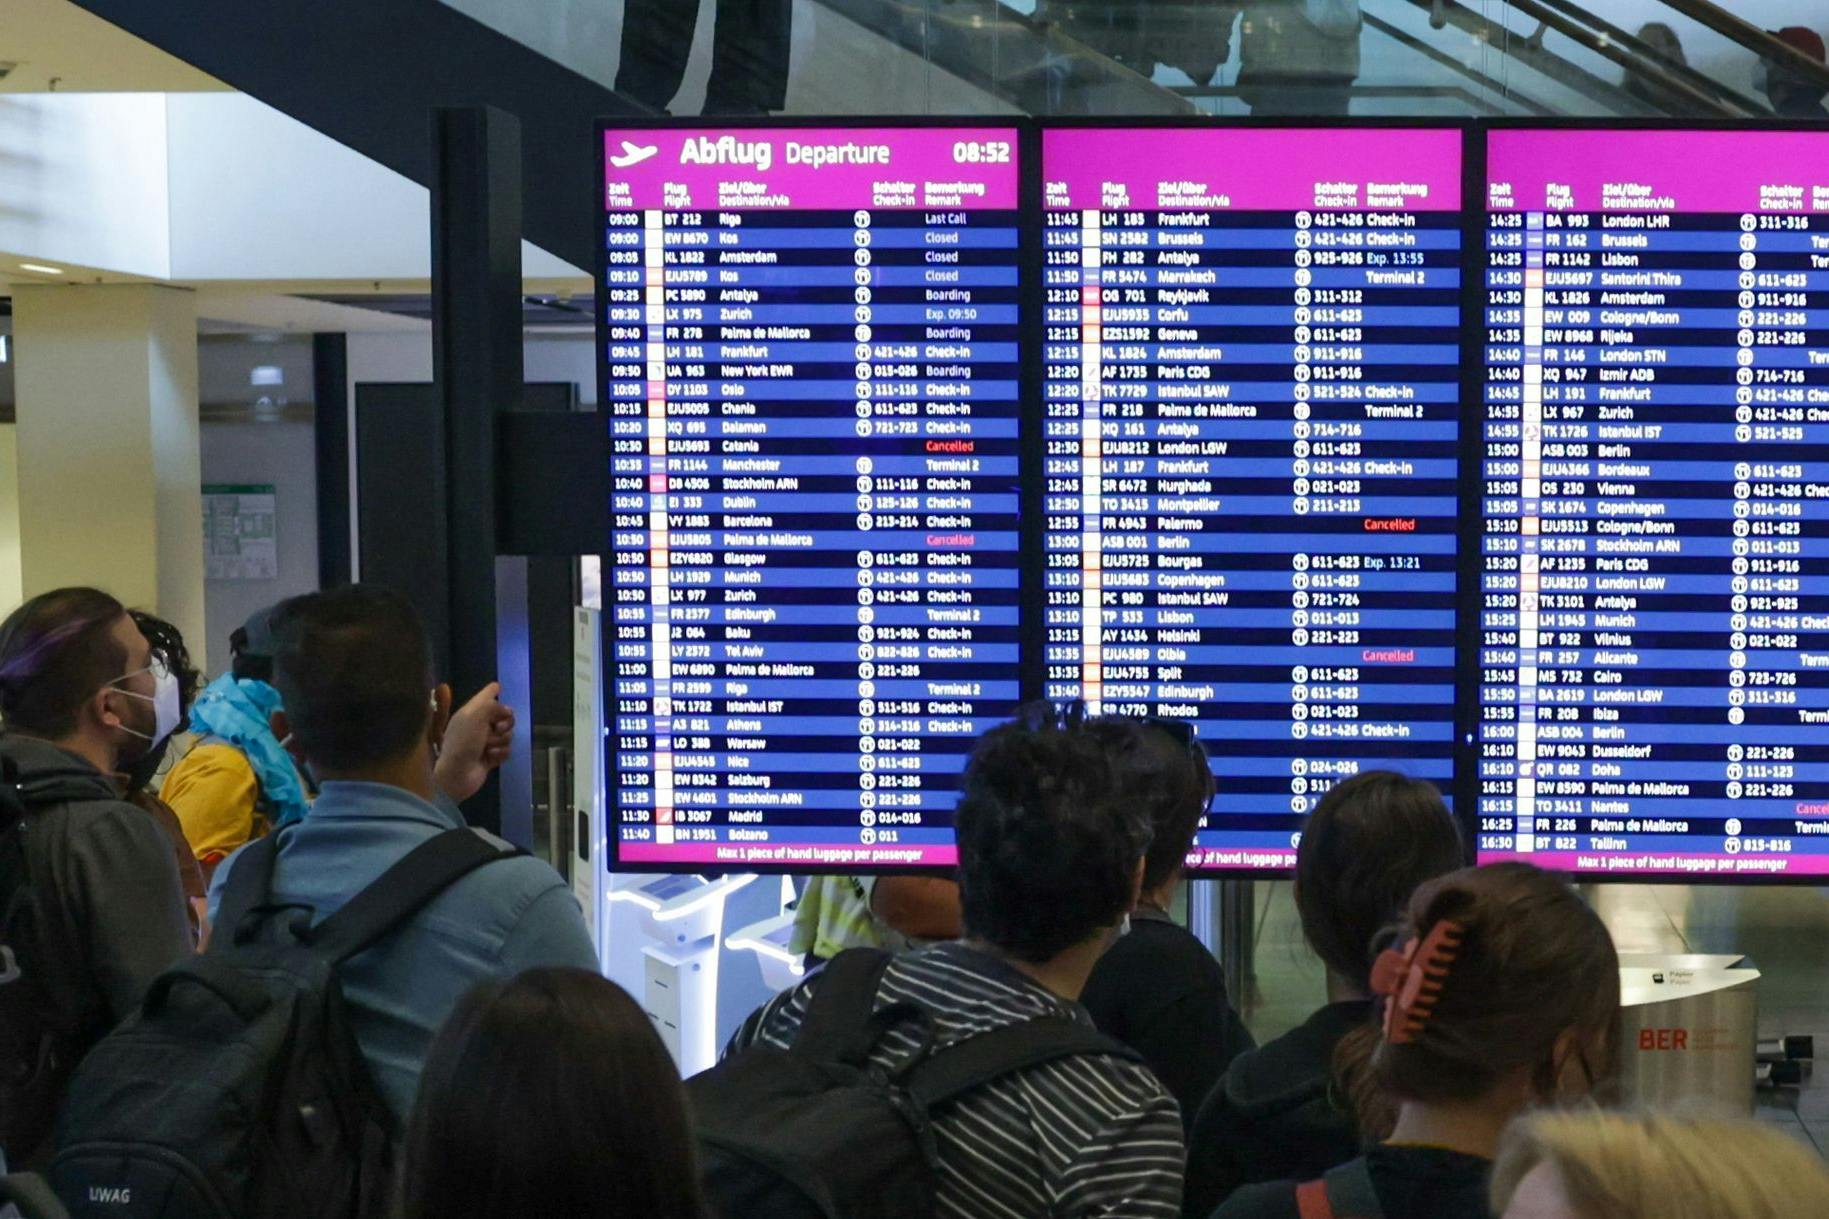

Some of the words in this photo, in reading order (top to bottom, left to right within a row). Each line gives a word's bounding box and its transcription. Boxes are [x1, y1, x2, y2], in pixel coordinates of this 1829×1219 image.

[680, 137, 771, 169] Abflug
[786, 143, 890, 168] Departure
[954, 143, 1009, 163] 08:52
[664, 182, 686, 197] Flug
[925, 182, 984, 196] Bemerkung
[1102, 182, 1125, 196] Flug
[1367, 182, 1427, 196] Bemerkung
[1546, 184, 1570, 198] Flug
[610, 196, 632, 207] Time
[664, 195, 690, 208] Flight
[719, 195, 790, 207] Destination/via
[873, 195, 915, 207] Check-in
[925, 195, 961, 206] Remark
[1046, 195, 1070, 206] Time
[1102, 194, 1129, 208] Flight
[1158, 194, 1230, 206] Destination/via
[1314, 195, 1356, 207] Check-in
[1367, 195, 1404, 207] Remark
[1490, 196, 1514, 208] Time
[1546, 196, 1574, 208] Flight
[1603, 196, 1674, 208] Destination/via
[1760, 196, 1802, 209] Check-in
[610, 214, 638, 225] 09:00
[720, 213, 741, 227] Riga
[926, 214, 945, 223] Last
[948, 214, 966, 223] Call
[1048, 213, 1078, 225] 11:45
[1159, 213, 1209, 225] Frankfurt
[1315, 214, 1363, 226] 421-426
[1367, 213, 1415, 226] Check-in
[1491, 215, 1521, 226] 14:25
[1603, 215, 1644, 227] London
[1647, 215, 1669, 227] LHR
[925, 232, 958, 243] Closed
[1158, 232, 1204, 245] Brussels
[720, 251, 776, 263] Amsterdam
[1367, 253, 1389, 266] Exp.
[1394, 253, 1423, 264] 13:55
[1602, 253, 1638, 265] Lisbon
[1158, 269, 1216, 283] Marrakech
[1366, 270, 1415, 284] Terminal
[1417, 271, 1424, 284] 2
[720, 289, 758, 303] Antalya
[926, 290, 970, 302] Boarding
[1048, 290, 1079, 302] 12:10
[1158, 289, 1209, 305] Reykjavik
[1601, 292, 1665, 304] Amsterdam
[720, 308, 752, 320] Zurich
[926, 308, 946, 322] Exp.
[948, 308, 977, 320] 09:50
[721, 327, 751, 338] Palma
[753, 327, 766, 339] de
[768, 327, 810, 338] Mallorca
[1601, 330, 1633, 344] Rijeka
[874, 346, 918, 358] 421-426
[925, 345, 971, 358] Check-in
[1600, 349, 1642, 362] London
[1644, 349, 1666, 362] STN
[722, 366, 744, 376] New
[746, 365, 768, 376] York
[770, 365, 793, 376] EWR
[927, 366, 970, 378] Boarding
[1158, 366, 1185, 378] Paris
[1187, 366, 1210, 378] CDG
[1757, 370, 1804, 382] 714-716
[614, 384, 641, 396] 10:05
[721, 383, 745, 396] Oslo
[722, 403, 755, 414] Chania
[1049, 404, 1078, 416] 12:25
[1599, 406, 1633, 419] Zurich
[926, 441, 973, 452] Cancelled
[1158, 442, 1199, 454] London
[1202, 442, 1227, 454] LGW
[1599, 444, 1630, 457] Berlin
[722, 458, 780, 471] Manchester
[926, 459, 971, 472] Terminal
[972, 459, 979, 471] 2
[1598, 463, 1650, 476] Bordeaux
[616, 478, 642, 489] 10:40
[723, 478, 775, 489] Stockholm
[776, 478, 798, 489] ARN
[1158, 479, 1211, 493] Hurghada
[1598, 482, 1635, 495] Vienna
[723, 496, 756, 508] Dublin
[1158, 497, 1220, 512] Montpellier
[724, 515, 772, 527] Barcelona
[1158, 517, 1203, 529] Palermo
[1365, 519, 1415, 530] Cancelled
[1597, 520, 1674, 532] Cologne/Bonn
[1596, 539, 1654, 551] Stockholm
[1655, 539, 1680, 551] ARN
[724, 552, 765, 565] Glasgow
[876, 553, 918, 564] 611-623
[927, 553, 971, 565] Check-in
[1158, 555, 1202, 569] Bourgas
[1364, 557, 1388, 569] Exp.
[1391, 557, 1419, 568] 13:21
[1487, 557, 1517, 569] 15:20
[1157, 573, 1225, 588] Copenhagen
[1049, 592, 1079, 604] 13:10
[1313, 593, 1359, 606] 721-724
[725, 608, 776, 621] Edinburgh
[1157, 610, 1194, 624] Lisbon
[1595, 614, 1636, 626] Munich
[1158, 630, 1200, 642] Helsinki
[1595, 633, 1631, 645] Vilnius
[725, 645, 741, 657] Tel
[742, 645, 764, 657] Aviv
[1158, 667, 1181, 681] Split
[1594, 670, 1622, 682] Cairo
[620, 701, 647, 711] 11:10
[727, 701, 766, 712] Istanbul
[768, 701, 783, 712] IST
[1158, 704, 1198, 716] Rhodos
[1594, 708, 1618, 720] Ibiza
[727, 738, 766, 749] Warsaw
[878, 739, 920, 750] 021-022
[1593, 745, 1651, 757] Dusseldorf
[1747, 747, 1794, 759] 221-226
[1592, 763, 1621, 776] Doha
[728, 774, 770, 788] Salzburg
[1483, 782, 1513, 793] 16:15
[729, 811, 762, 822] Madrid
[1482, 818, 1512, 830] 16:25
[1590, 837, 1627, 850] Tallinn
[717, 848, 737, 858] Max
[739, 848, 745, 858] 1
[748, 847, 773, 860] piece
[775, 847, 785, 858] of
[787, 848, 811, 858] hand
[814, 848, 852, 861] luggage
[855, 851, 871, 861] per
[873, 850, 922, 861] passenger
[1216, 852, 1241, 863] hand
[1244, 852, 1282, 867] luggage
[1578, 858, 1598, 867] Max
[1601, 858, 1606, 867] 1
[1609, 857, 1635, 868] piece
[1637, 857, 1647, 867] of
[1649, 857, 1674, 867] hand
[1677, 857, 1716, 869] luggage
[1718, 860, 1735, 869] per
[1737, 860, 1787, 870] passenger
[1638, 1028, 1687, 1050] BER
